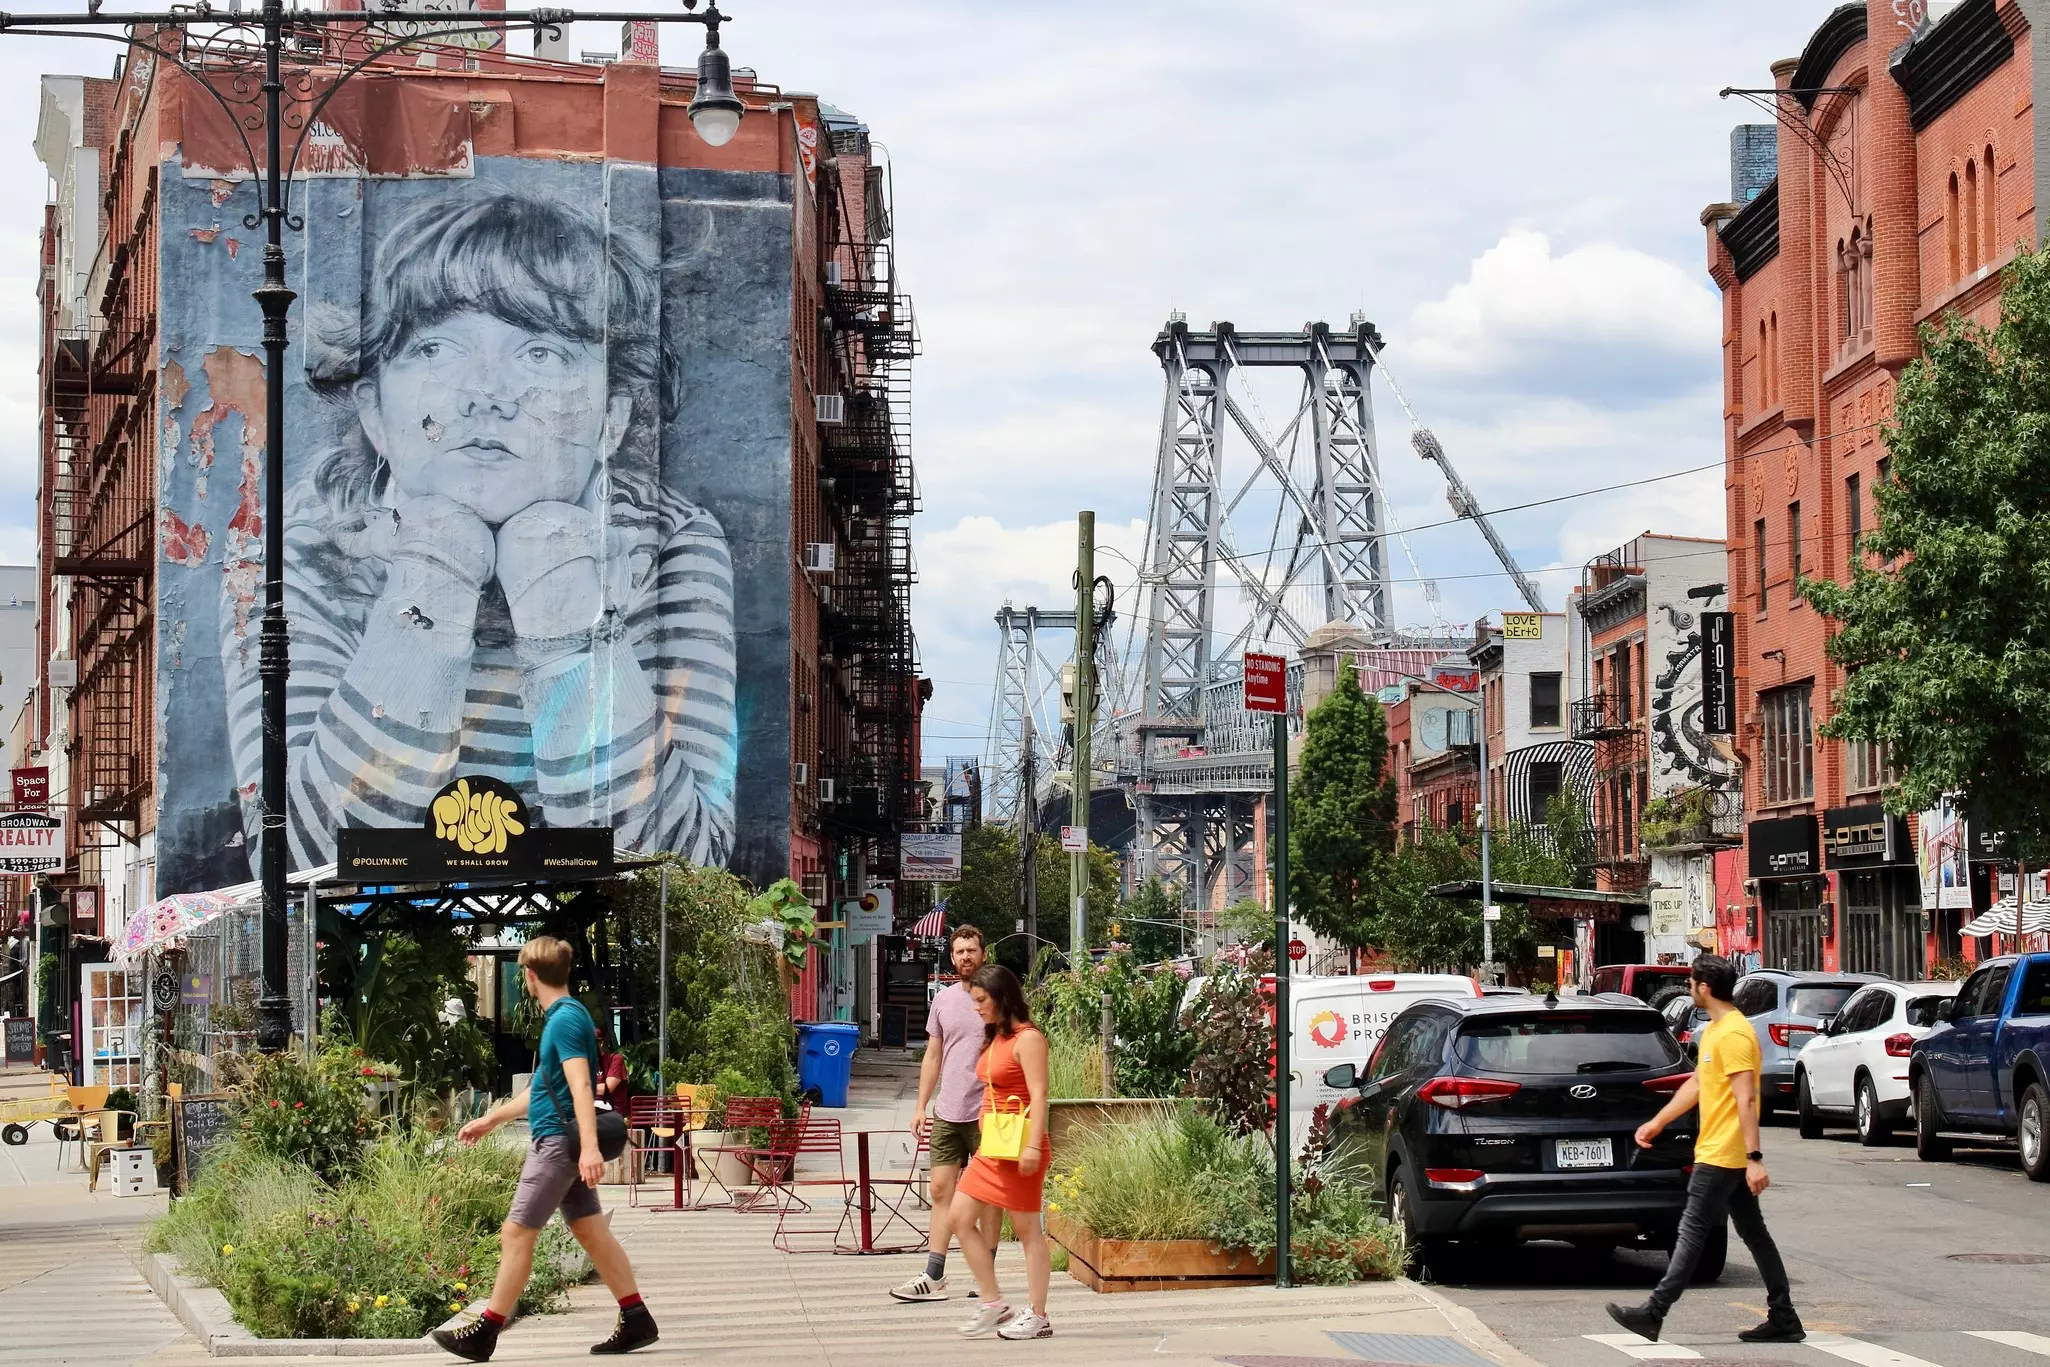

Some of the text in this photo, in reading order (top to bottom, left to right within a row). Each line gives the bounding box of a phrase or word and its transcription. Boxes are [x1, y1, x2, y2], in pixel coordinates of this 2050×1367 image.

[1506, 615, 1537, 626] LOVE
[1246, 658, 1281, 673] NO STANDING
[1246, 672, 1269, 685] Anytime
[16, 776, 46, 787] Space
[23, 788, 41, 798] For
[0, 818, 50, 828] BROADWAY
[352, 857, 408, 867] @POLLYN.NYC
[543, 858, 598, 867] #WeShallGrow
[1673, 900, 1683, 909] UP
[1288, 945, 1306, 955] STOP
[1352, 1012, 1399, 1025] BRISC
[1353, 1029, 1384, 1040] PRO
[186, 1119, 205, 1129] Cold
[1474, 1137, 1515, 1145] TUCSON
[1562, 1146, 1607, 1161] KEB 7601
